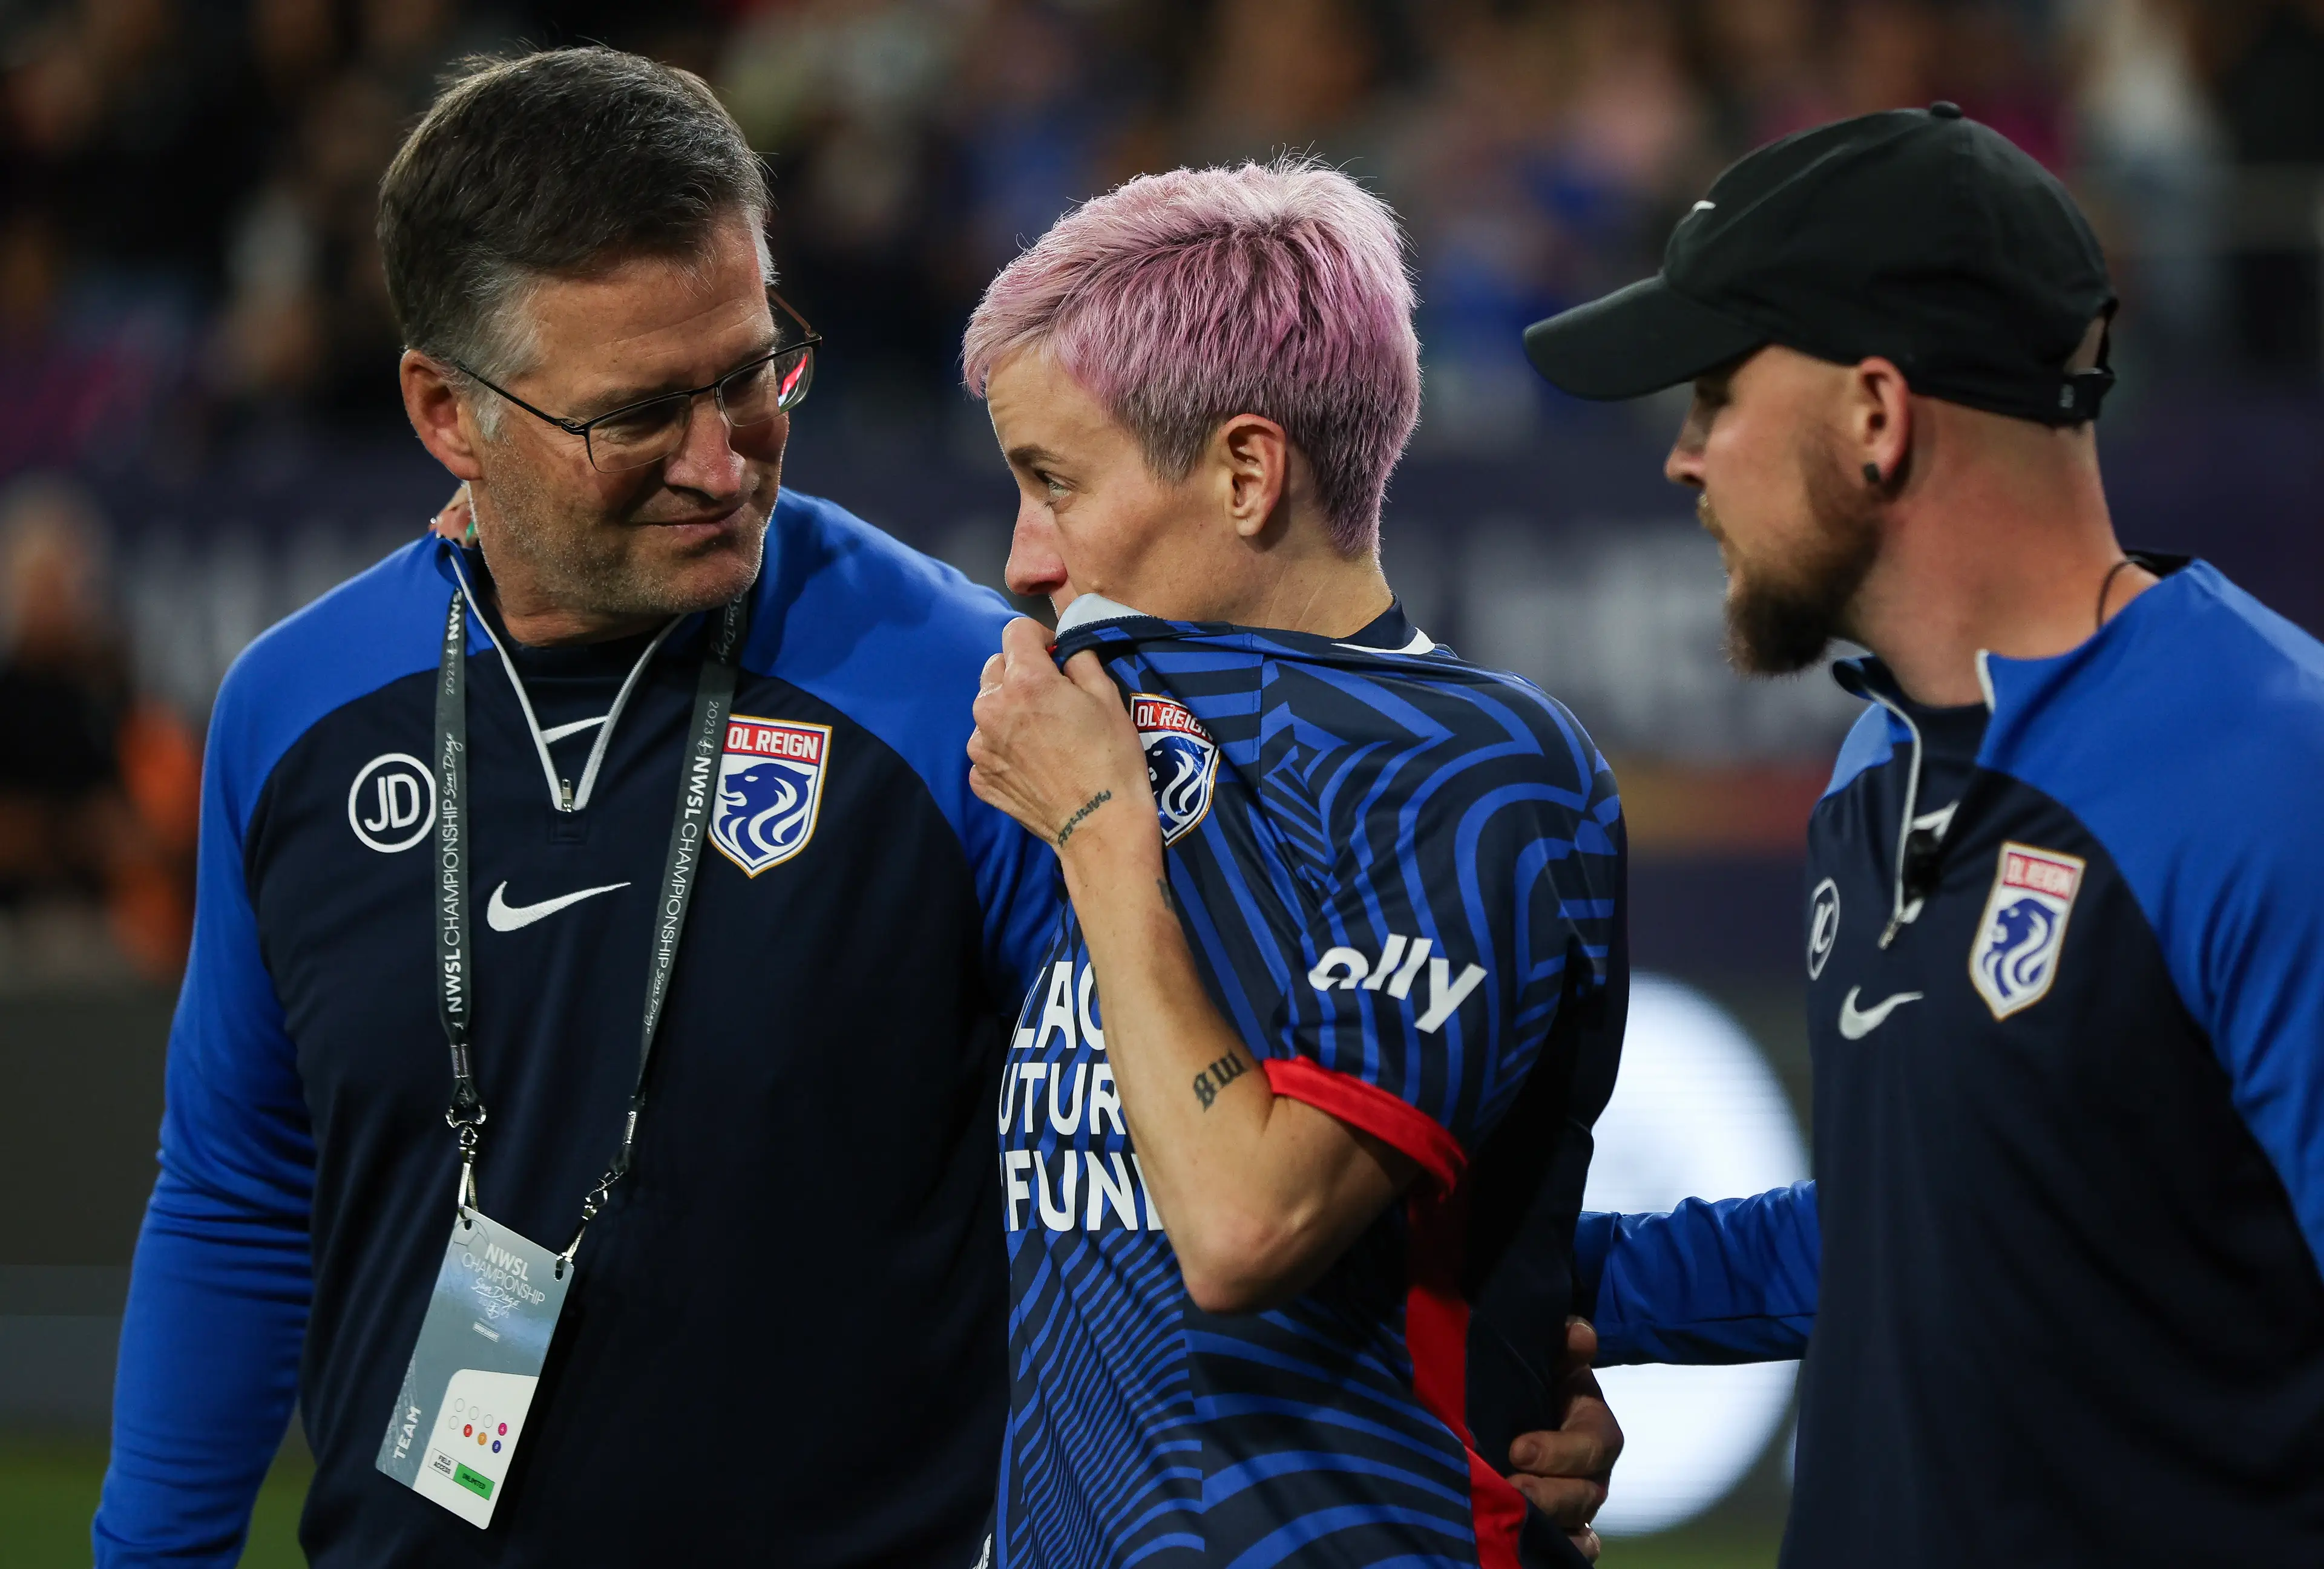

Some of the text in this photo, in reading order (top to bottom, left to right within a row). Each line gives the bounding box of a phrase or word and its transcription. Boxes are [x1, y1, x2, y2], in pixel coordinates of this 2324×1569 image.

[447, 587, 462, 640] NWS
[704, 700, 719, 734] 2023
[727, 727, 819, 760] OL REIGN
[1137, 705, 1157, 727] OL
[364, 774, 420, 832] JD
[684, 756, 711, 819] NWSL
[442, 799, 460, 946] CHAMPIONSHIP
[658, 822, 698, 968] CHAMPIONSHIP
[444, 948, 463, 1014] NWSL
[1013, 961, 1106, 1050] LAC
[999, 1063, 1126, 1135] UTUR
[462, 1253, 545, 1305] CHAMPIONSHIP
[485, 1243, 528, 1281] NWSL
[393, 1405, 422, 1459] TEAM
